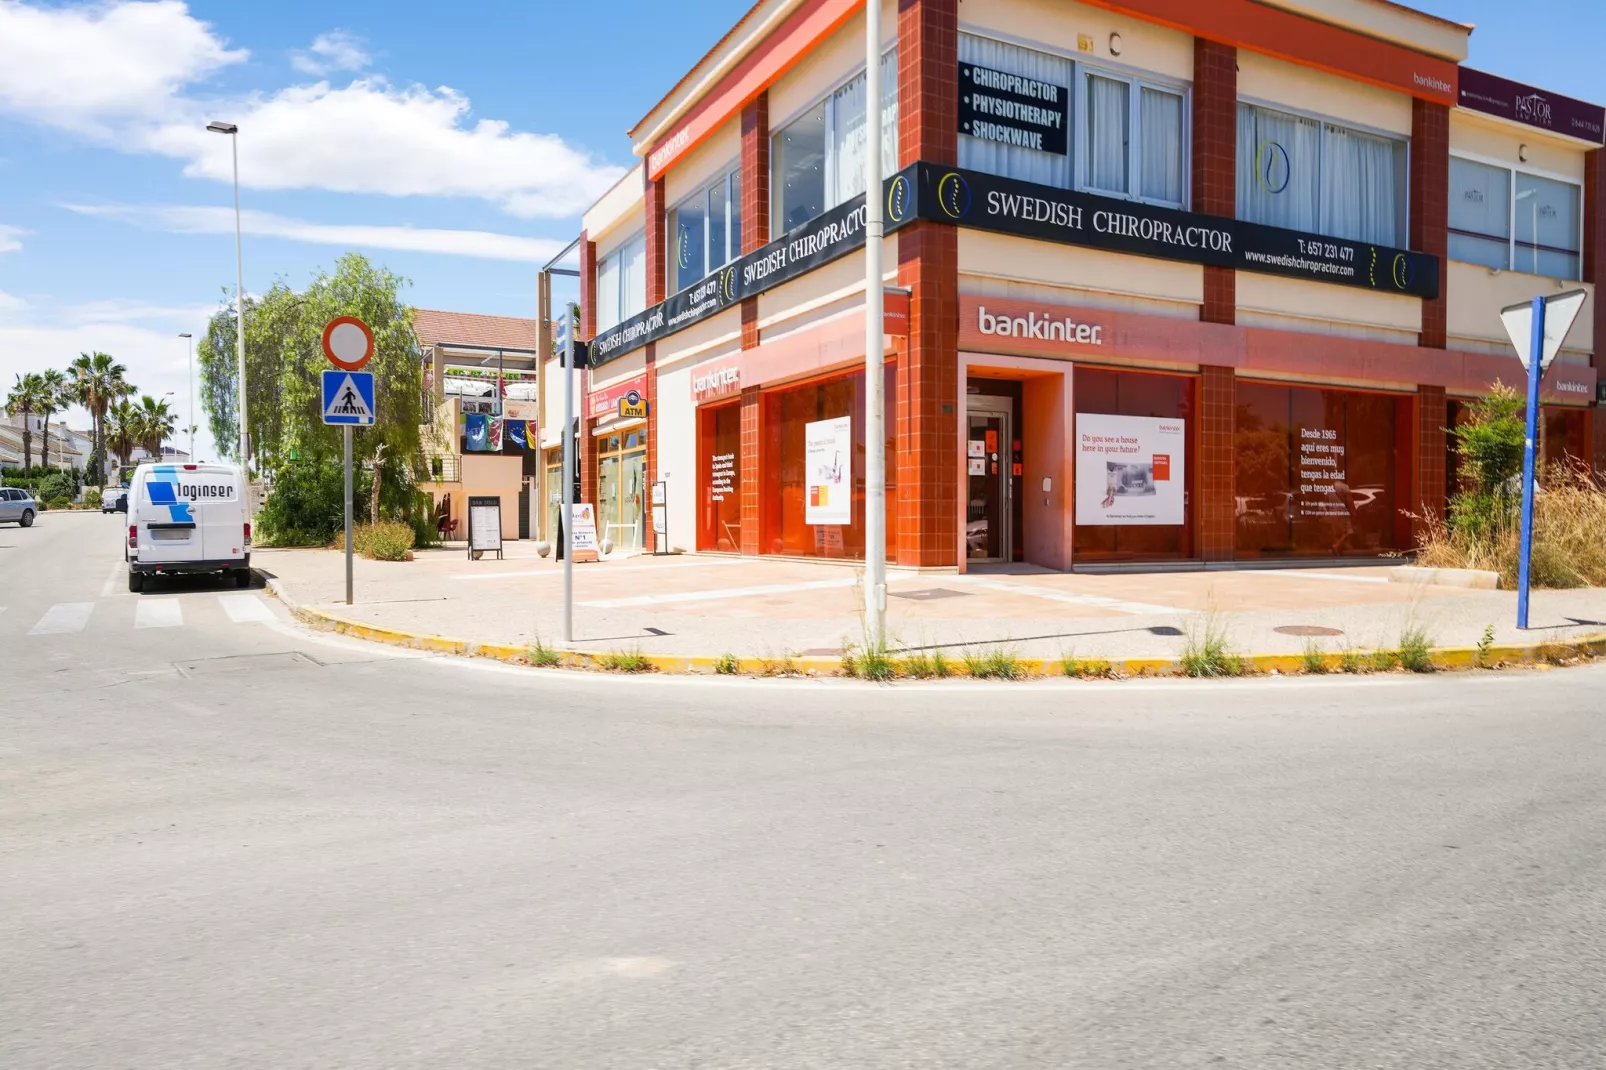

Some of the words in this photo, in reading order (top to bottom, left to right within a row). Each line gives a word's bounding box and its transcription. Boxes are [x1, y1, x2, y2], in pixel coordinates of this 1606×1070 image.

[973, 67, 1058, 102] CHIROPRACTOR
[972, 93, 1061, 129] PHYSIOTHERAPY
[1515, 93, 1551, 119] PASTOR
[972, 119, 1043, 150] SHOCKWAVE
[987, 190, 1083, 230] SWEDISH
[1093, 210, 1233, 252] CHIROPRACTOR
[743, 247, 787, 286] SWEDISH
[789, 204, 867, 262] CHIROPRACTO
[1298, 239, 1306, 254] T:
[1308, 241, 1322, 256] 657
[1325, 243, 1338, 259] 231
[1340, 246, 1354, 261] 477
[1244, 250, 1354, 276] www.swedishchiropractor.com
[600, 334, 621, 355] SWEDISH
[622, 312, 664, 344] CHIROPRACTOR
[624, 407, 643, 416] ATM
[1082, 434, 1091, 443] Do
[1092, 436, 1103, 445] you
[1120, 435, 1138, 445] house
[1301, 428, 1320, 438] Desde
[1321, 429, 1337, 440] 1965
[1082, 443, 1096, 452] here
[1105, 446, 1118, 455] your
[1119, 445, 1141, 454] future?
[1316, 445, 1330, 453] eres
[1330, 445, 1345, 456] muy
[1300, 454, 1337, 468] bienvenido,
[1300, 469, 1322, 481] tengas
[1322, 469, 1330, 479] la
[1329, 470, 1345, 480] edad
[177, 482, 233, 501] loginser
[1300, 484, 1313, 495] que
